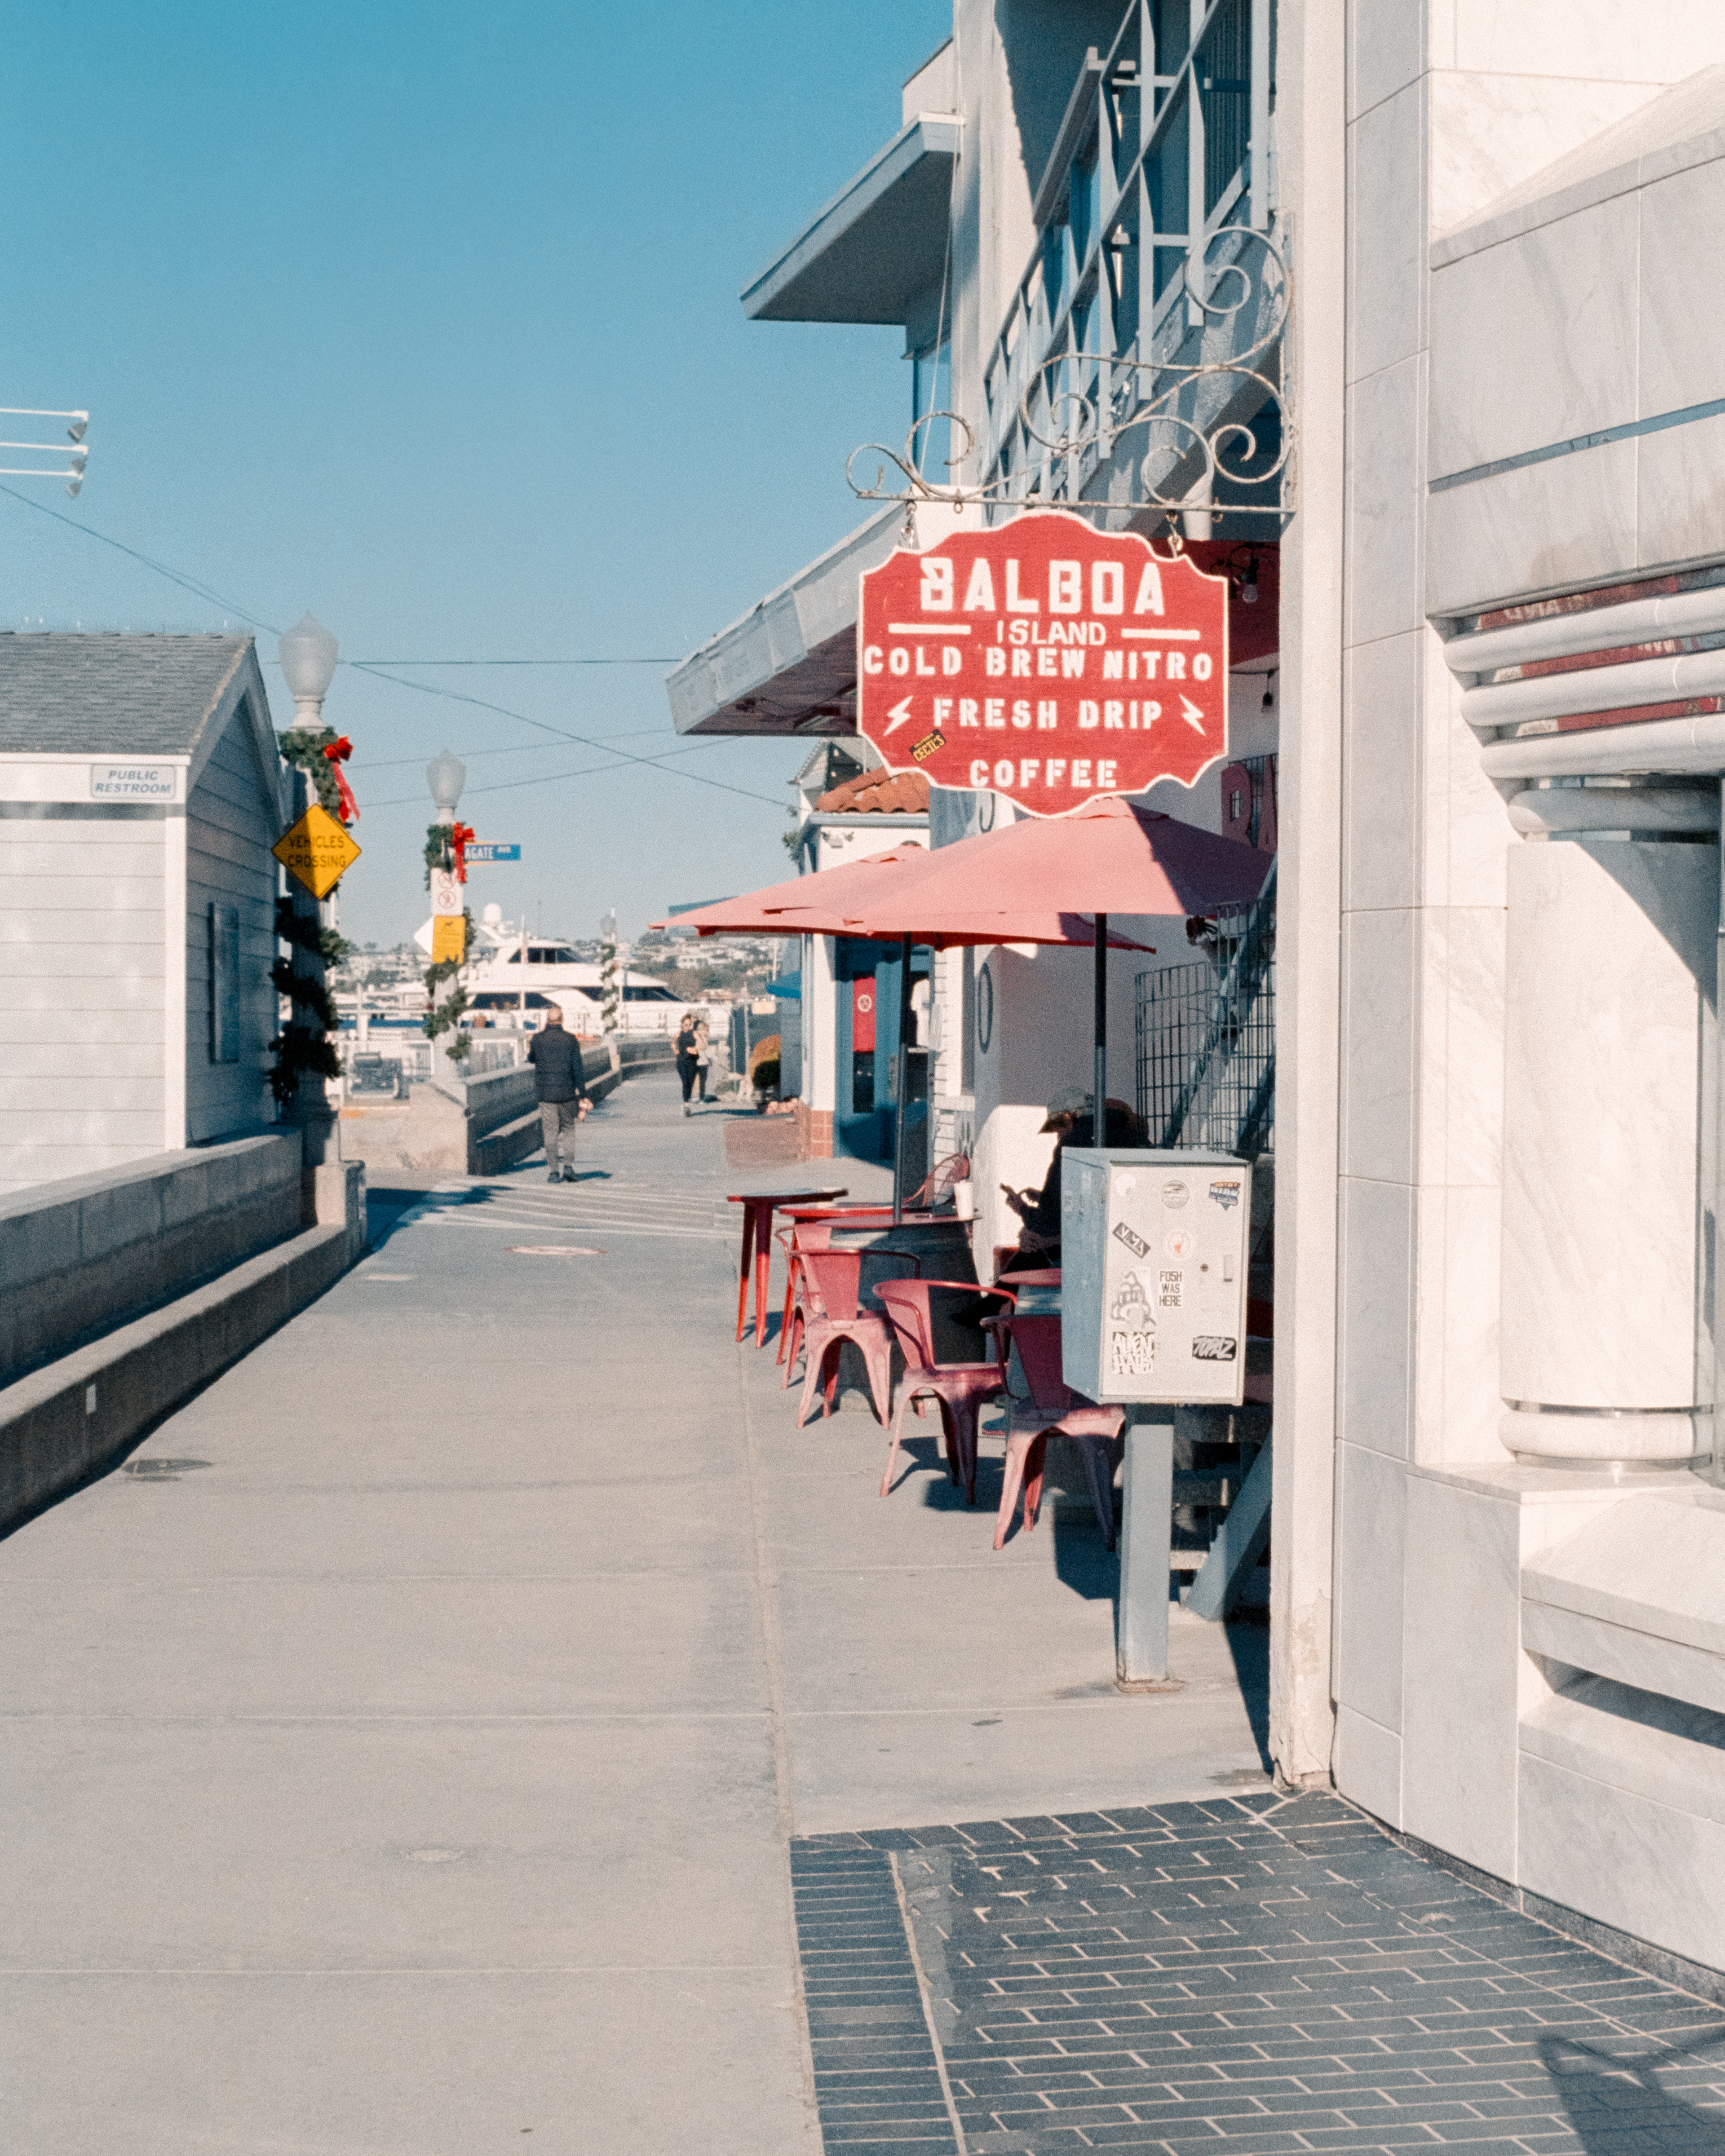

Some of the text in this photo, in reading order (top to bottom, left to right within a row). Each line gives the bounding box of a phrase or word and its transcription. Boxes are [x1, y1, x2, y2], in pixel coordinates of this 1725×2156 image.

[921, 557, 1165, 615] BALBOA
[997, 619, 1106, 646] ISLAND
[863, 646, 1212, 681] COLD BREW NITRO
[933, 698, 1163, 730] FRESH DRIP
[913, 735, 945, 762] CECIL'S
[108, 770, 159, 781] PUBLIC
[969, 759, 1118, 788] COFFEE
[95, 782, 171, 793] RESTROOM
[289, 835, 345, 848] VEHICLES
[464, 847, 494, 859] AGATE
[288, 854, 346, 867] CROSSING
[1162, 1283, 1180, 1294] WAS
[1159, 1295, 1181, 1307] HERE
